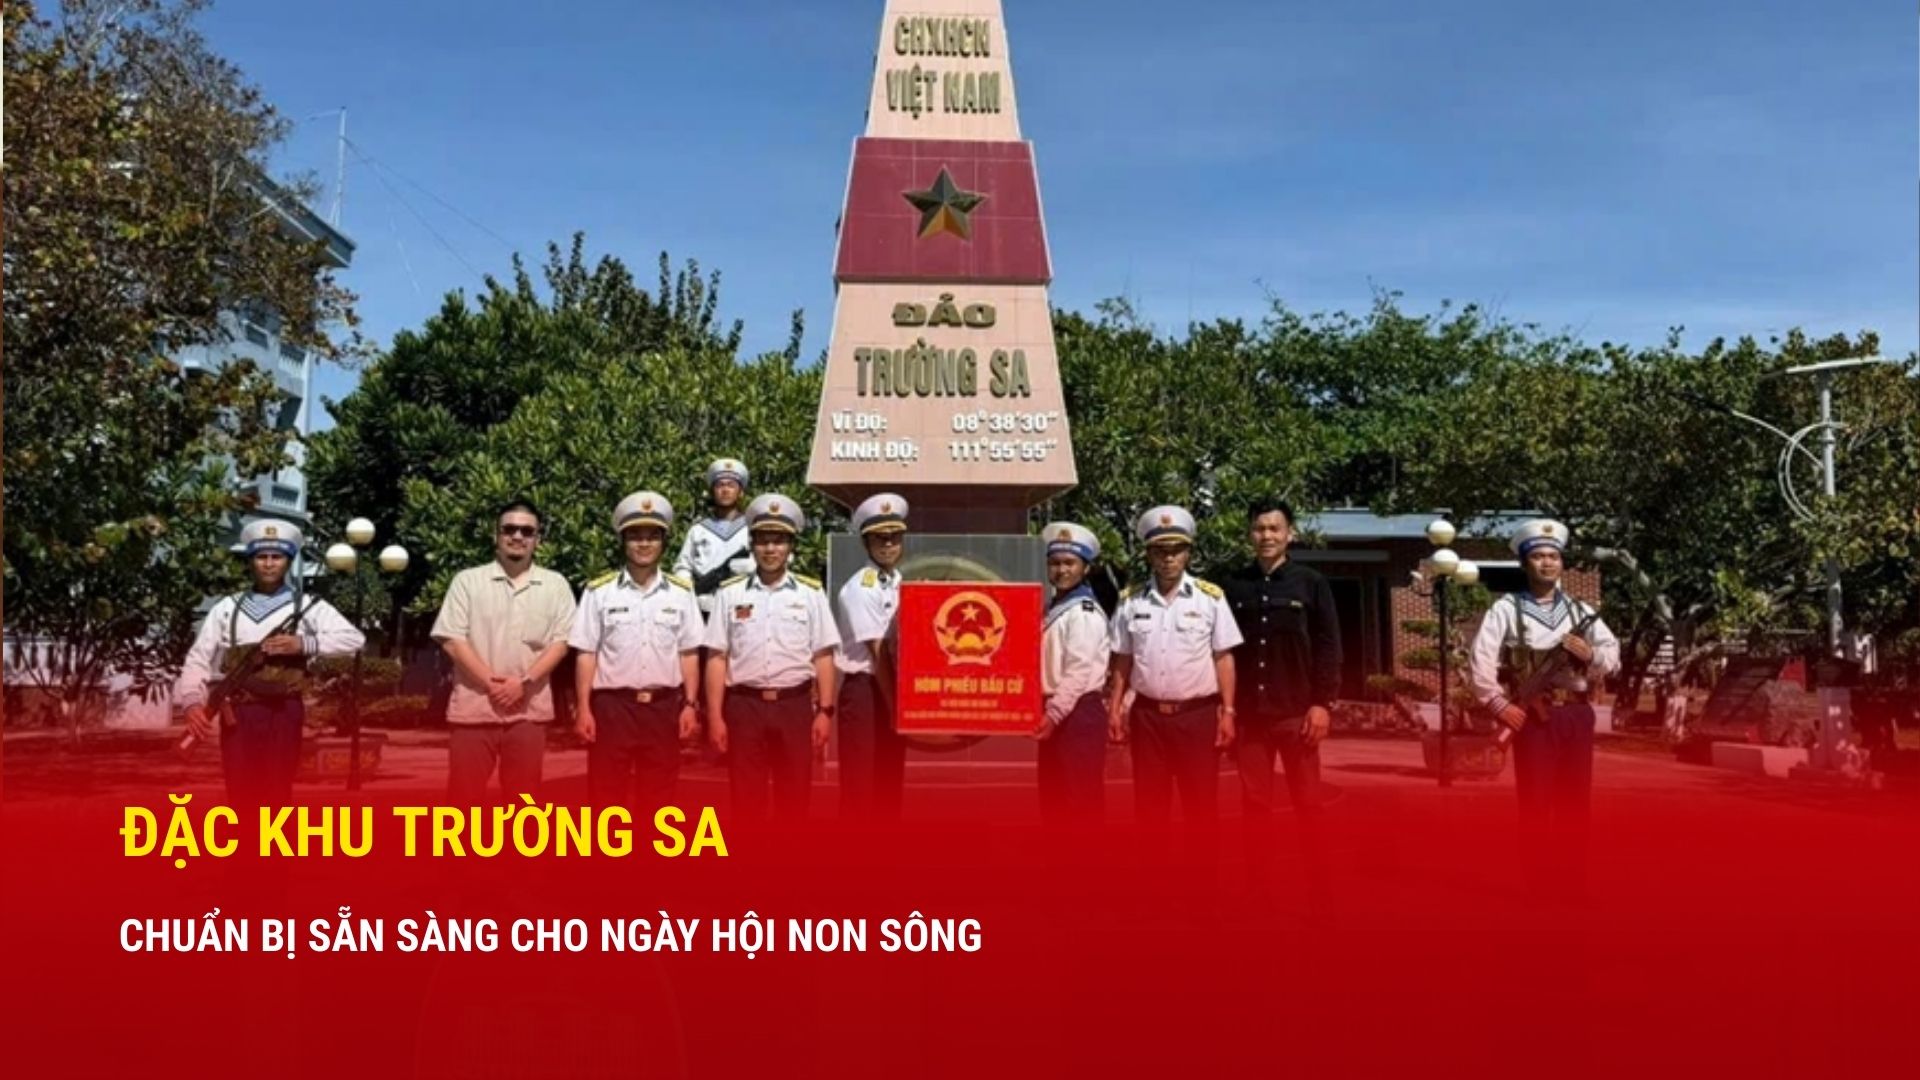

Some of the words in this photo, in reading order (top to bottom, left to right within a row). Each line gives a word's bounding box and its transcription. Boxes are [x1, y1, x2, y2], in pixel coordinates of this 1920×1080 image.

[894, 16, 991, 58] CHXHCN
[886, 62, 937, 120] VIỆT
[943, 70, 1001, 114] NAM
[892, 293, 996, 328] ĐẢO
[854, 337, 977, 398] TRƯỜNG
[989, 349, 1031, 399] SA
[831, 408, 851, 434] VĨ
[830, 440, 880, 462] KINH
